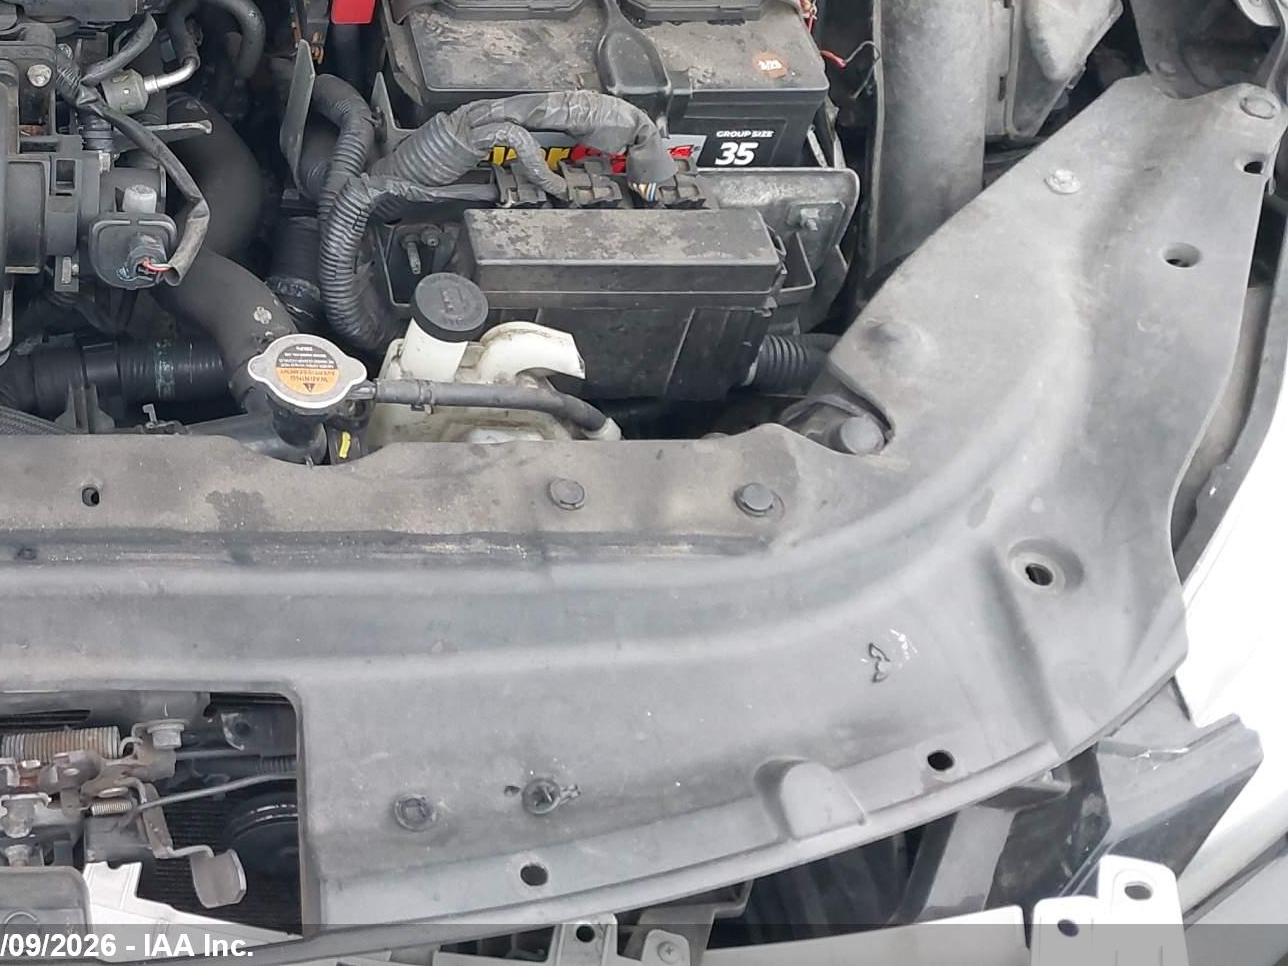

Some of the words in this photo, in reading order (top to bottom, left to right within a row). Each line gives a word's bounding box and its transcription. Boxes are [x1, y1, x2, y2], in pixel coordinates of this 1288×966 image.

[716, 130, 752, 138] GROUP
[752, 130, 775, 138] SIZE
[714, 141, 760, 166] 35
